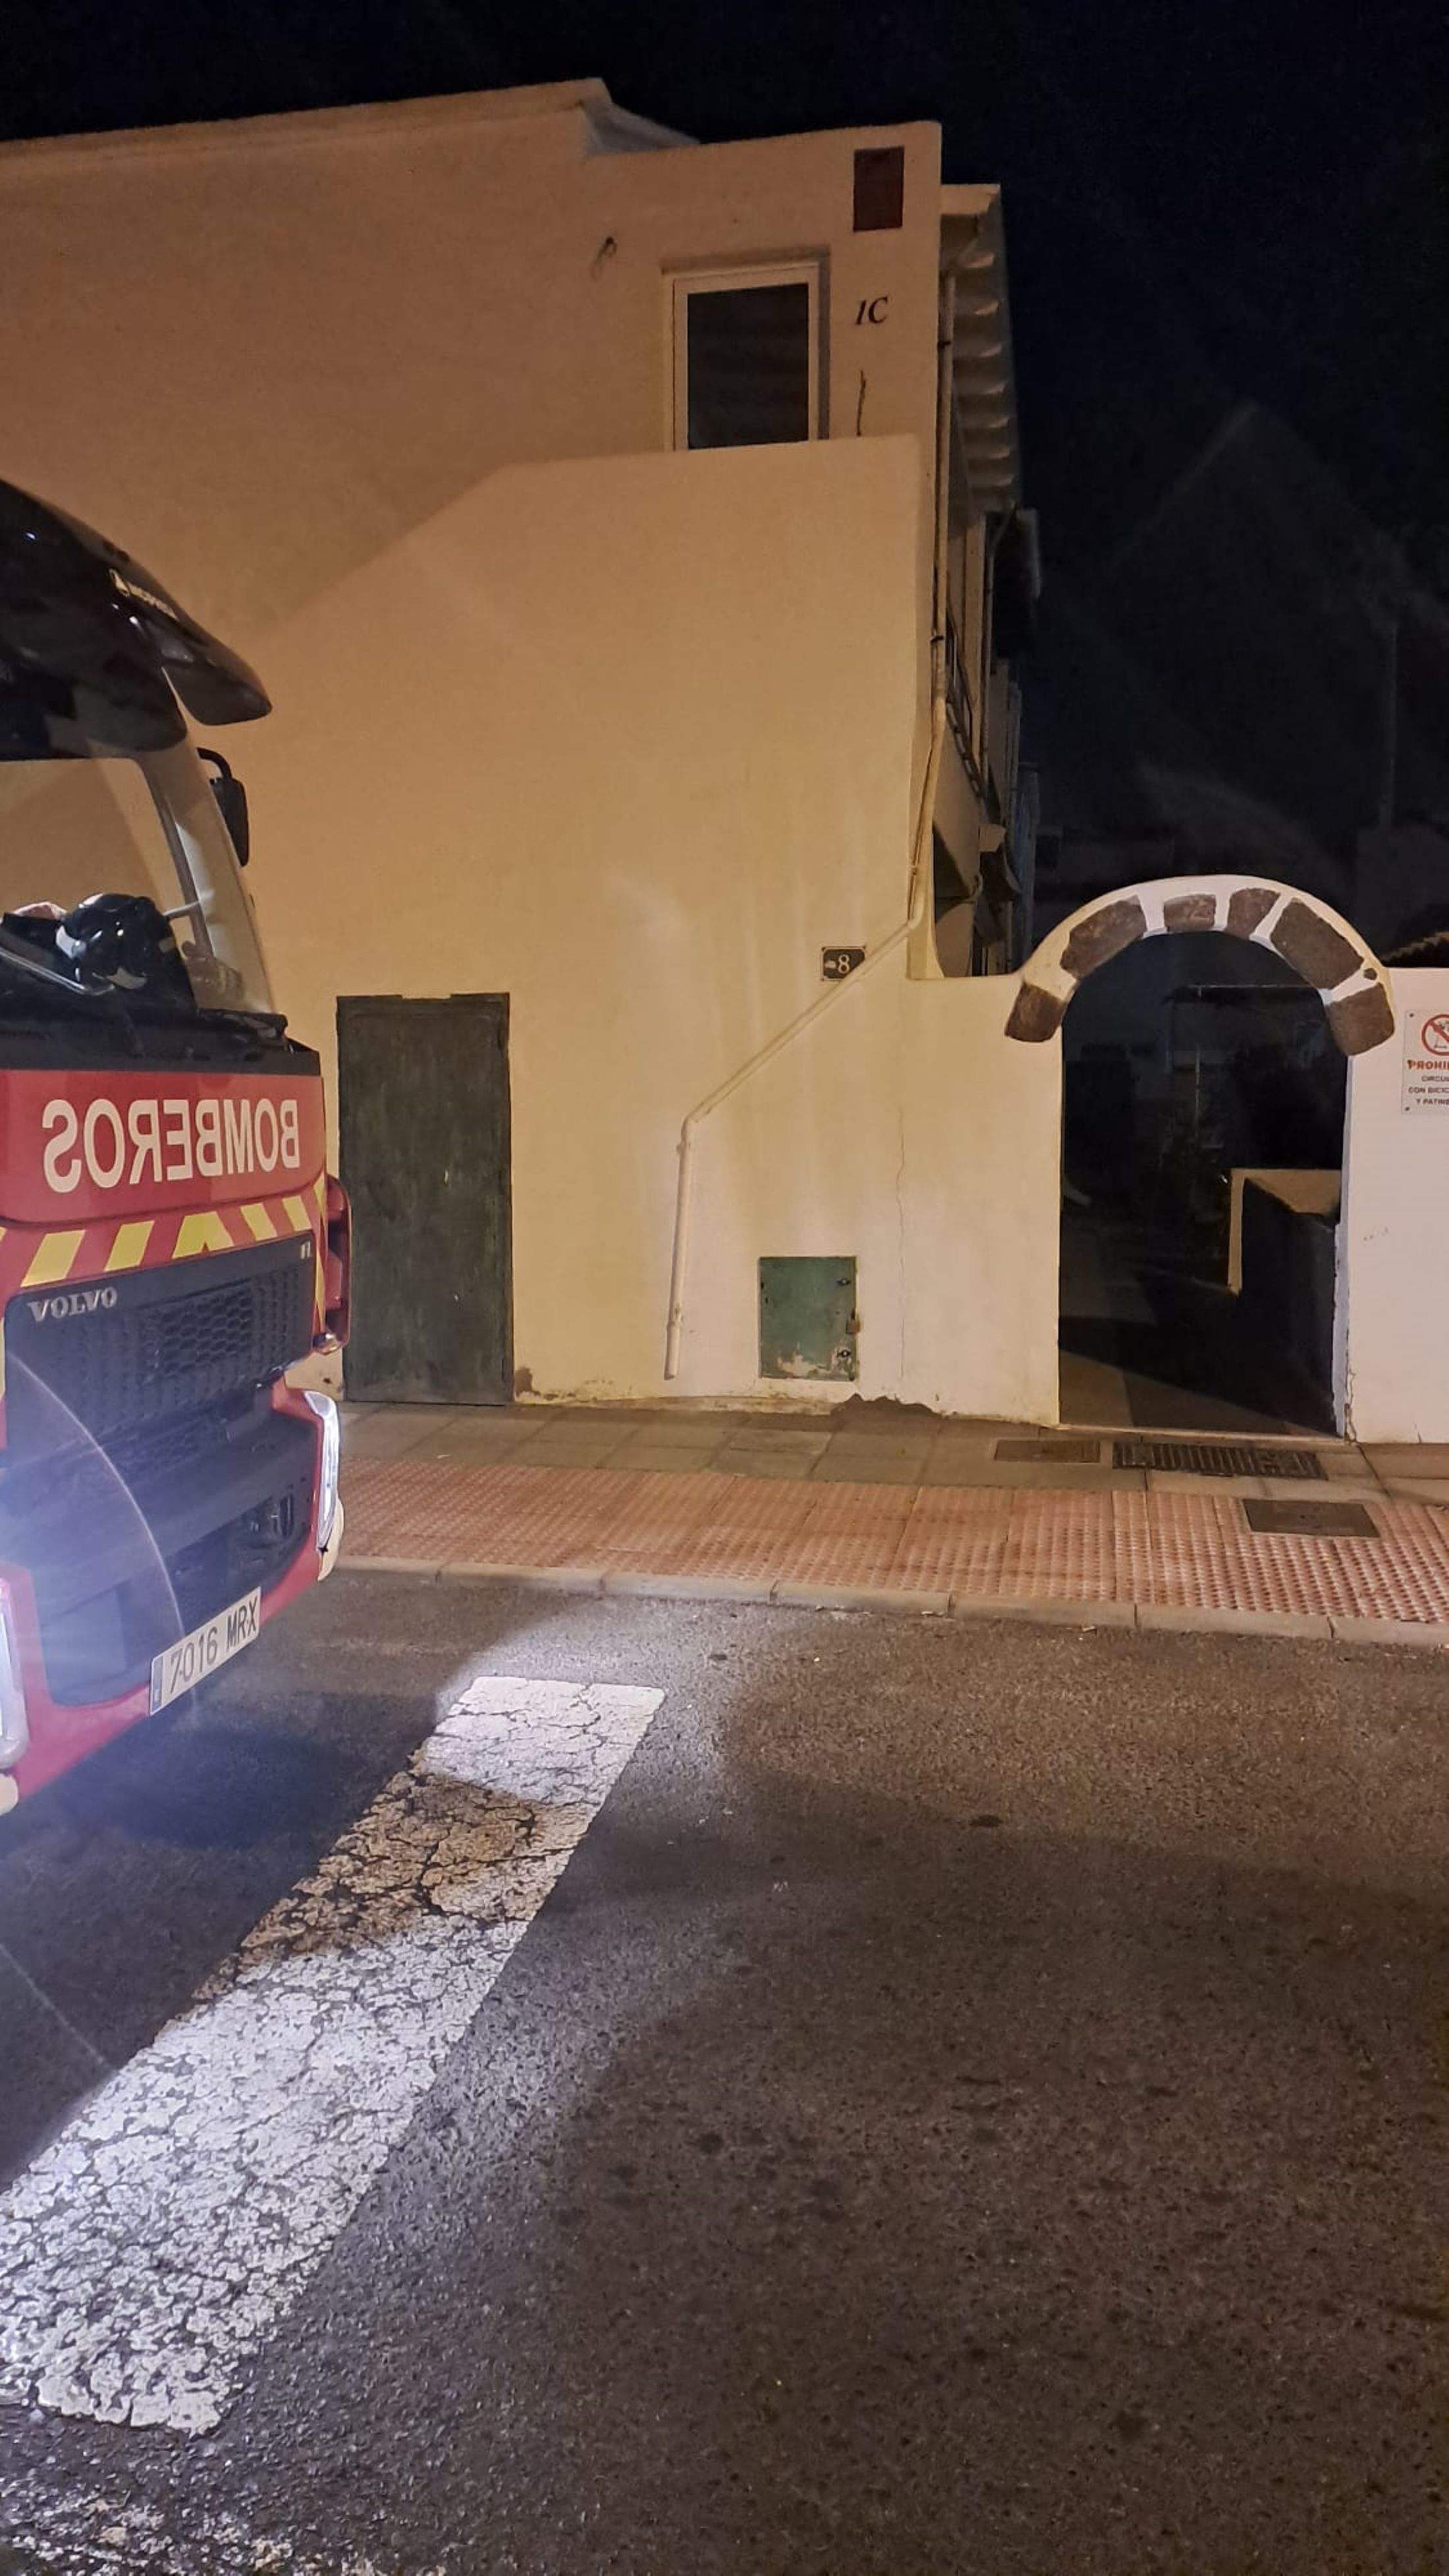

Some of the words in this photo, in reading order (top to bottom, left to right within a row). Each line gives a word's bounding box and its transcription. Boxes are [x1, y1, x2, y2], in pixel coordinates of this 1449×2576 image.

[27, 1286, 117, 1322] VOLVO
[171, 1626, 218, 1693] 7016
[227, 1596, 258, 1653] MRX
